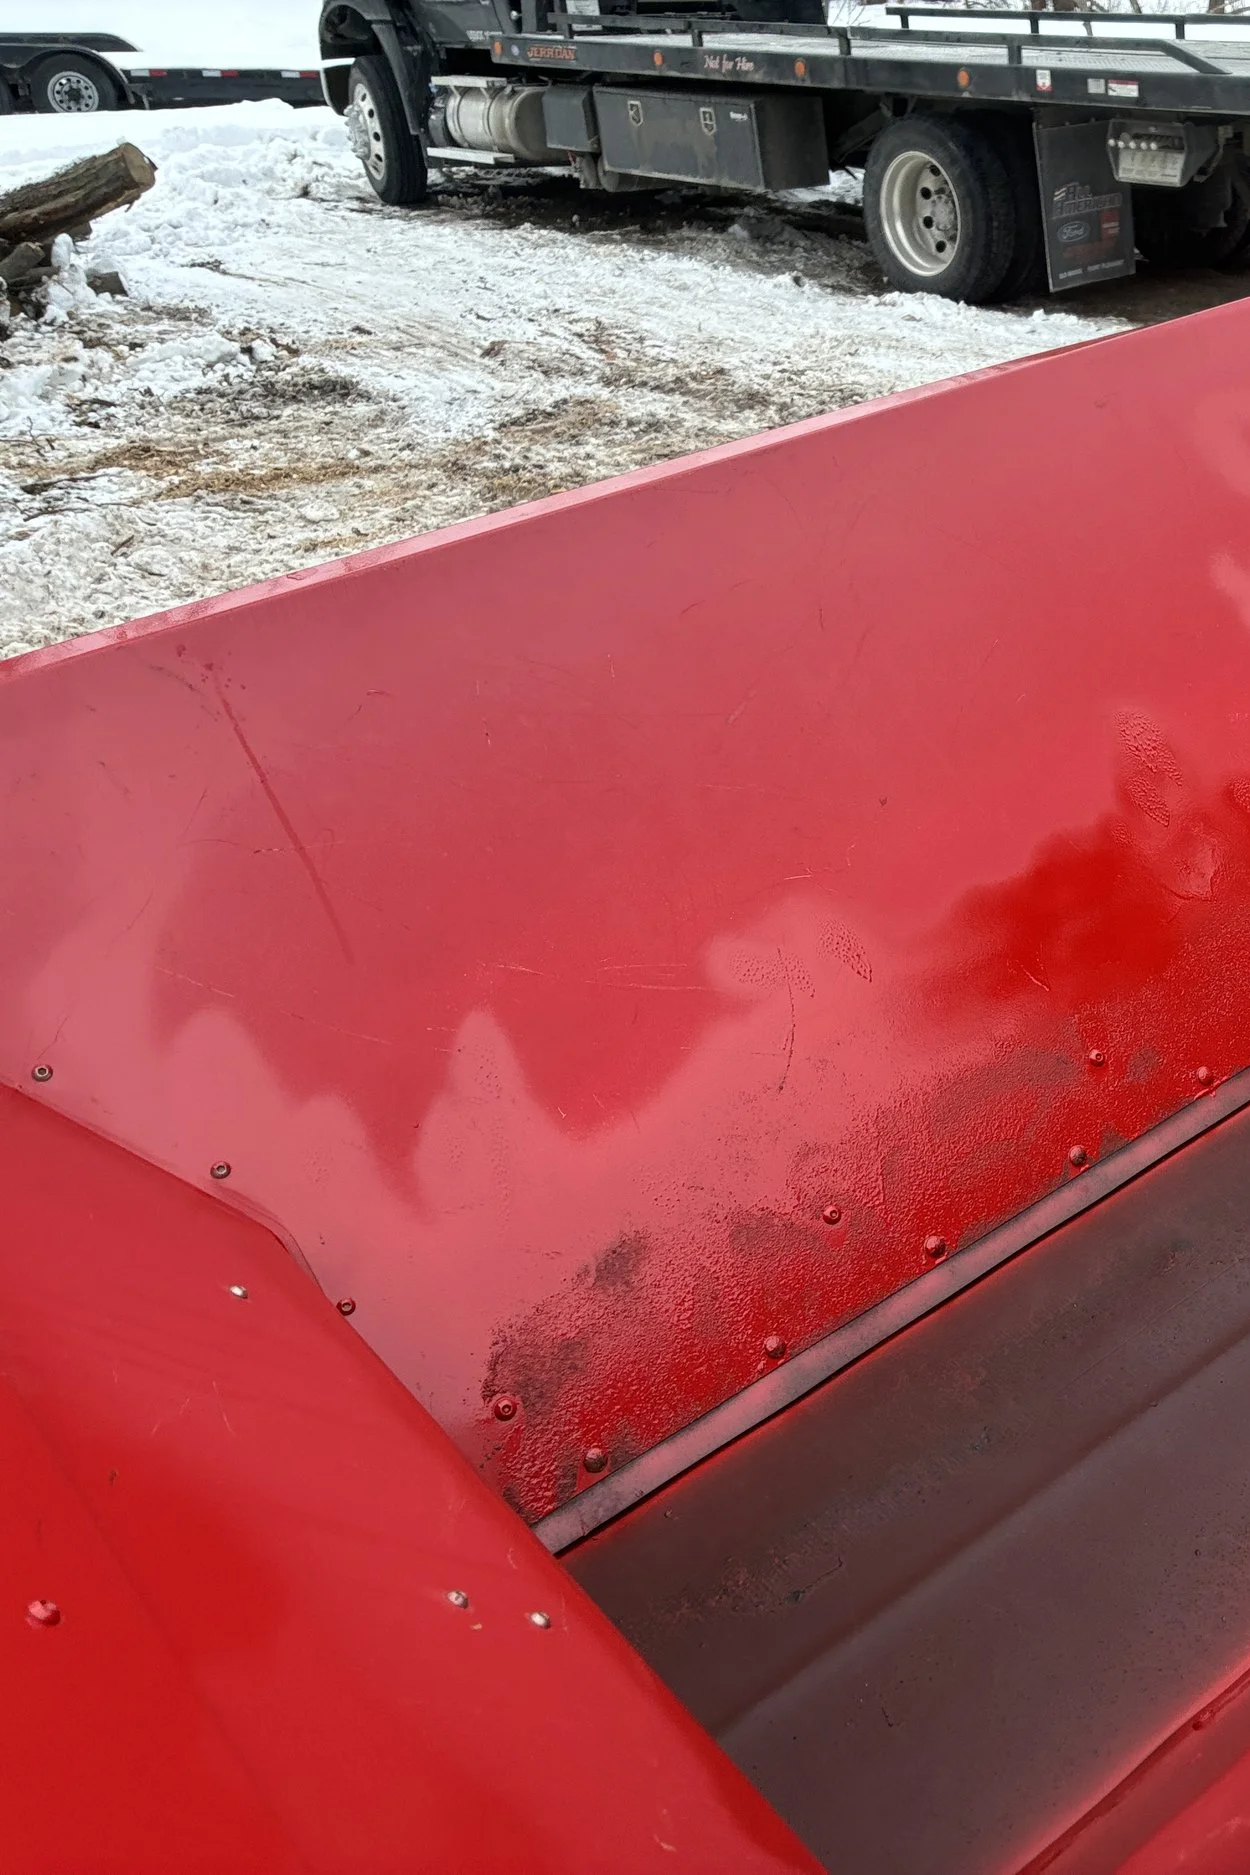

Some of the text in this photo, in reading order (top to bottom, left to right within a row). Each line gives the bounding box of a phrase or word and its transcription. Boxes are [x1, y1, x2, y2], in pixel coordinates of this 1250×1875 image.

[704, 53, 755, 73] Not for Hire
